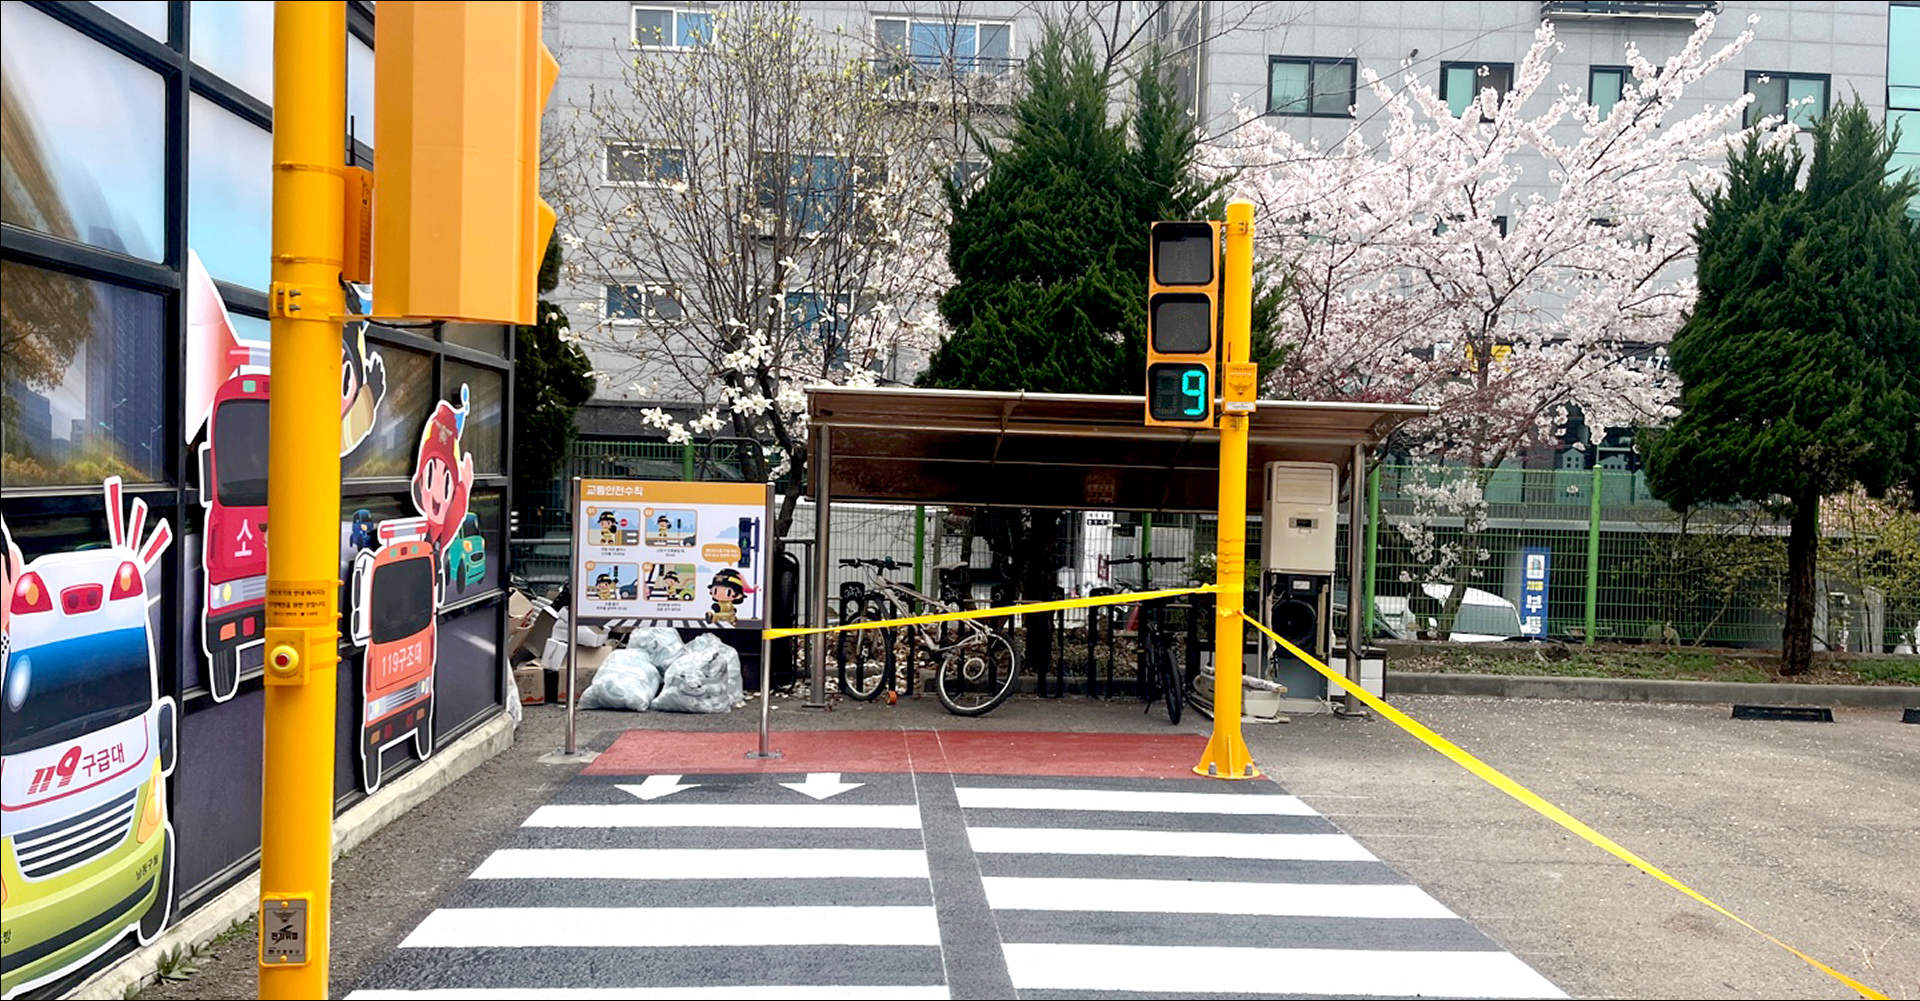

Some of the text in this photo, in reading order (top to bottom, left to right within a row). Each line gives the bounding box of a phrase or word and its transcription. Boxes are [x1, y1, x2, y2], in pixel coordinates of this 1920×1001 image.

[1182, 370, 1205, 415] 9
[586, 485, 644, 497] 교통안전수칙
[381, 641, 422, 677] 119구조대
